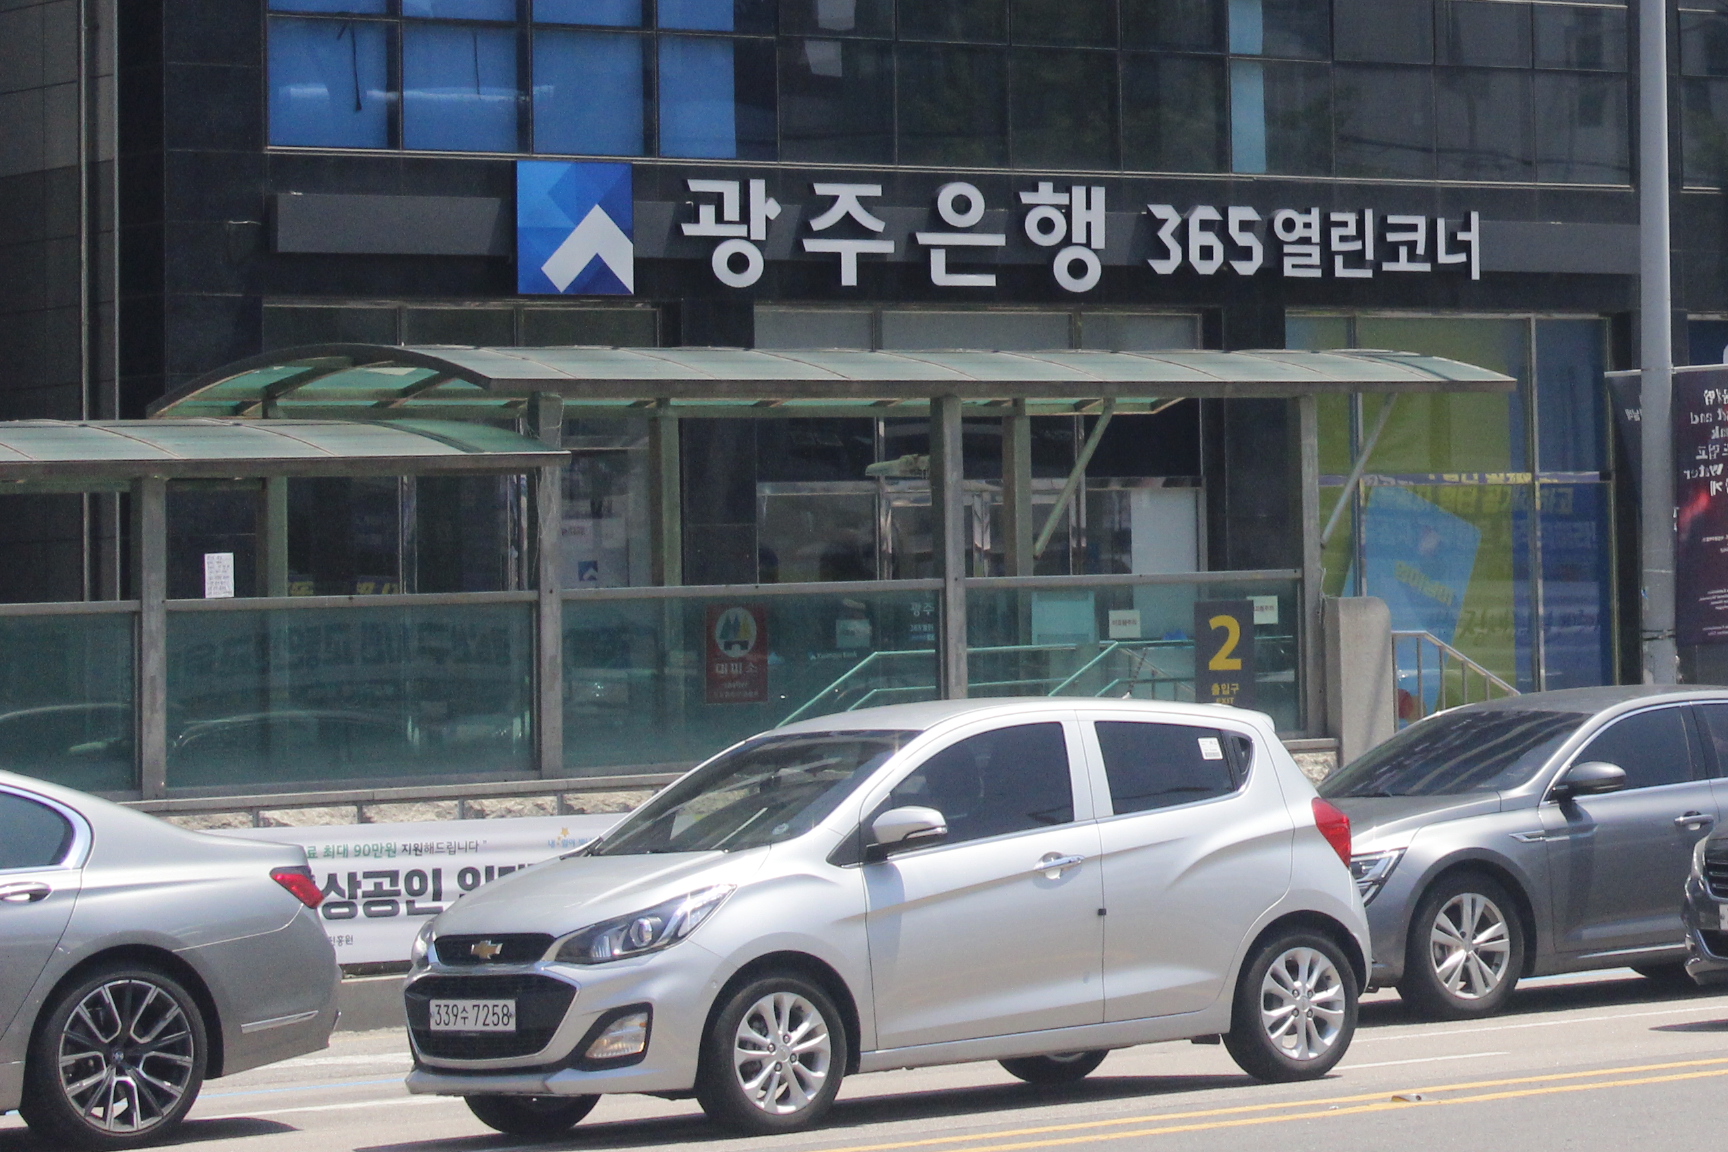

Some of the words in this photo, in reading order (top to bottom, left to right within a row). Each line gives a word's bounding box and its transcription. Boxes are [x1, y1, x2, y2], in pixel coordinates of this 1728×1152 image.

[680, 176, 1107, 294] 광주은행
[1208, 615, 1243, 671] 2
[715, 662, 758, 675] 대피소
[1211, 683, 1240, 696] 출입구
[322, 843, 349, 859] 최대
[353, 841, 397, 859] 90만원
